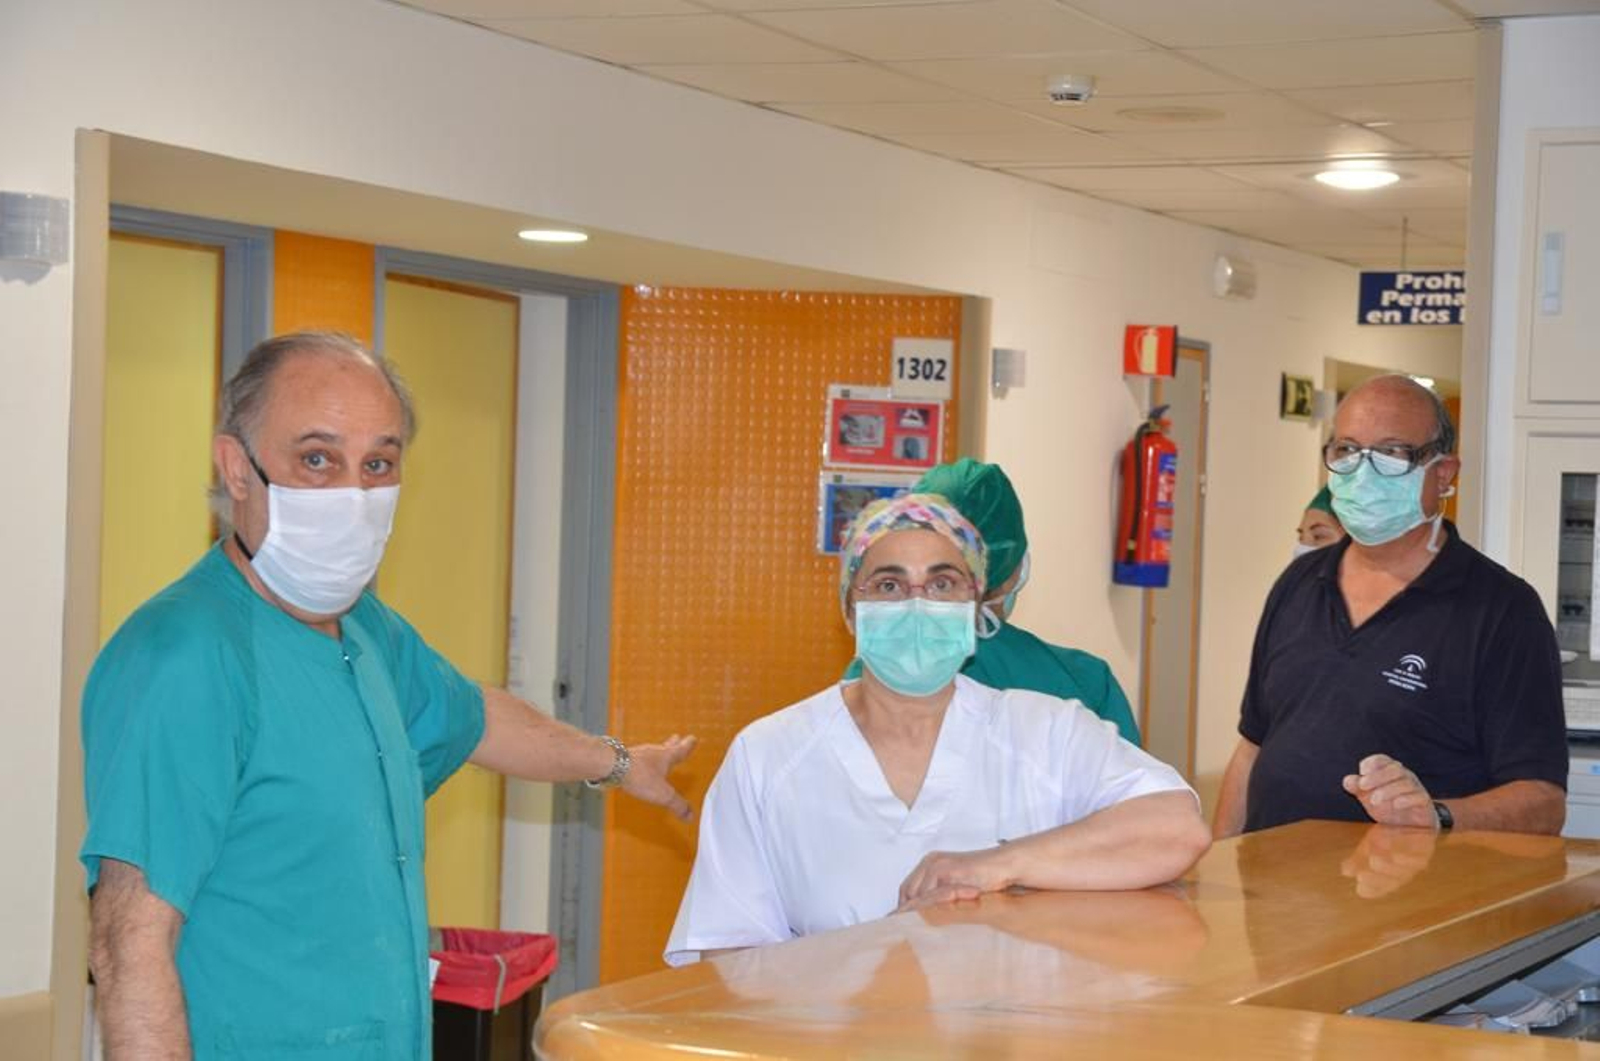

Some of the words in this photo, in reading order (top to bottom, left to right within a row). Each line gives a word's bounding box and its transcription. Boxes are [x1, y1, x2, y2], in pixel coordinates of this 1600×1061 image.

[1366, 310, 1402, 324] en
[1410, 307, 1450, 324] los
[898, 357, 947, 381] 1302
